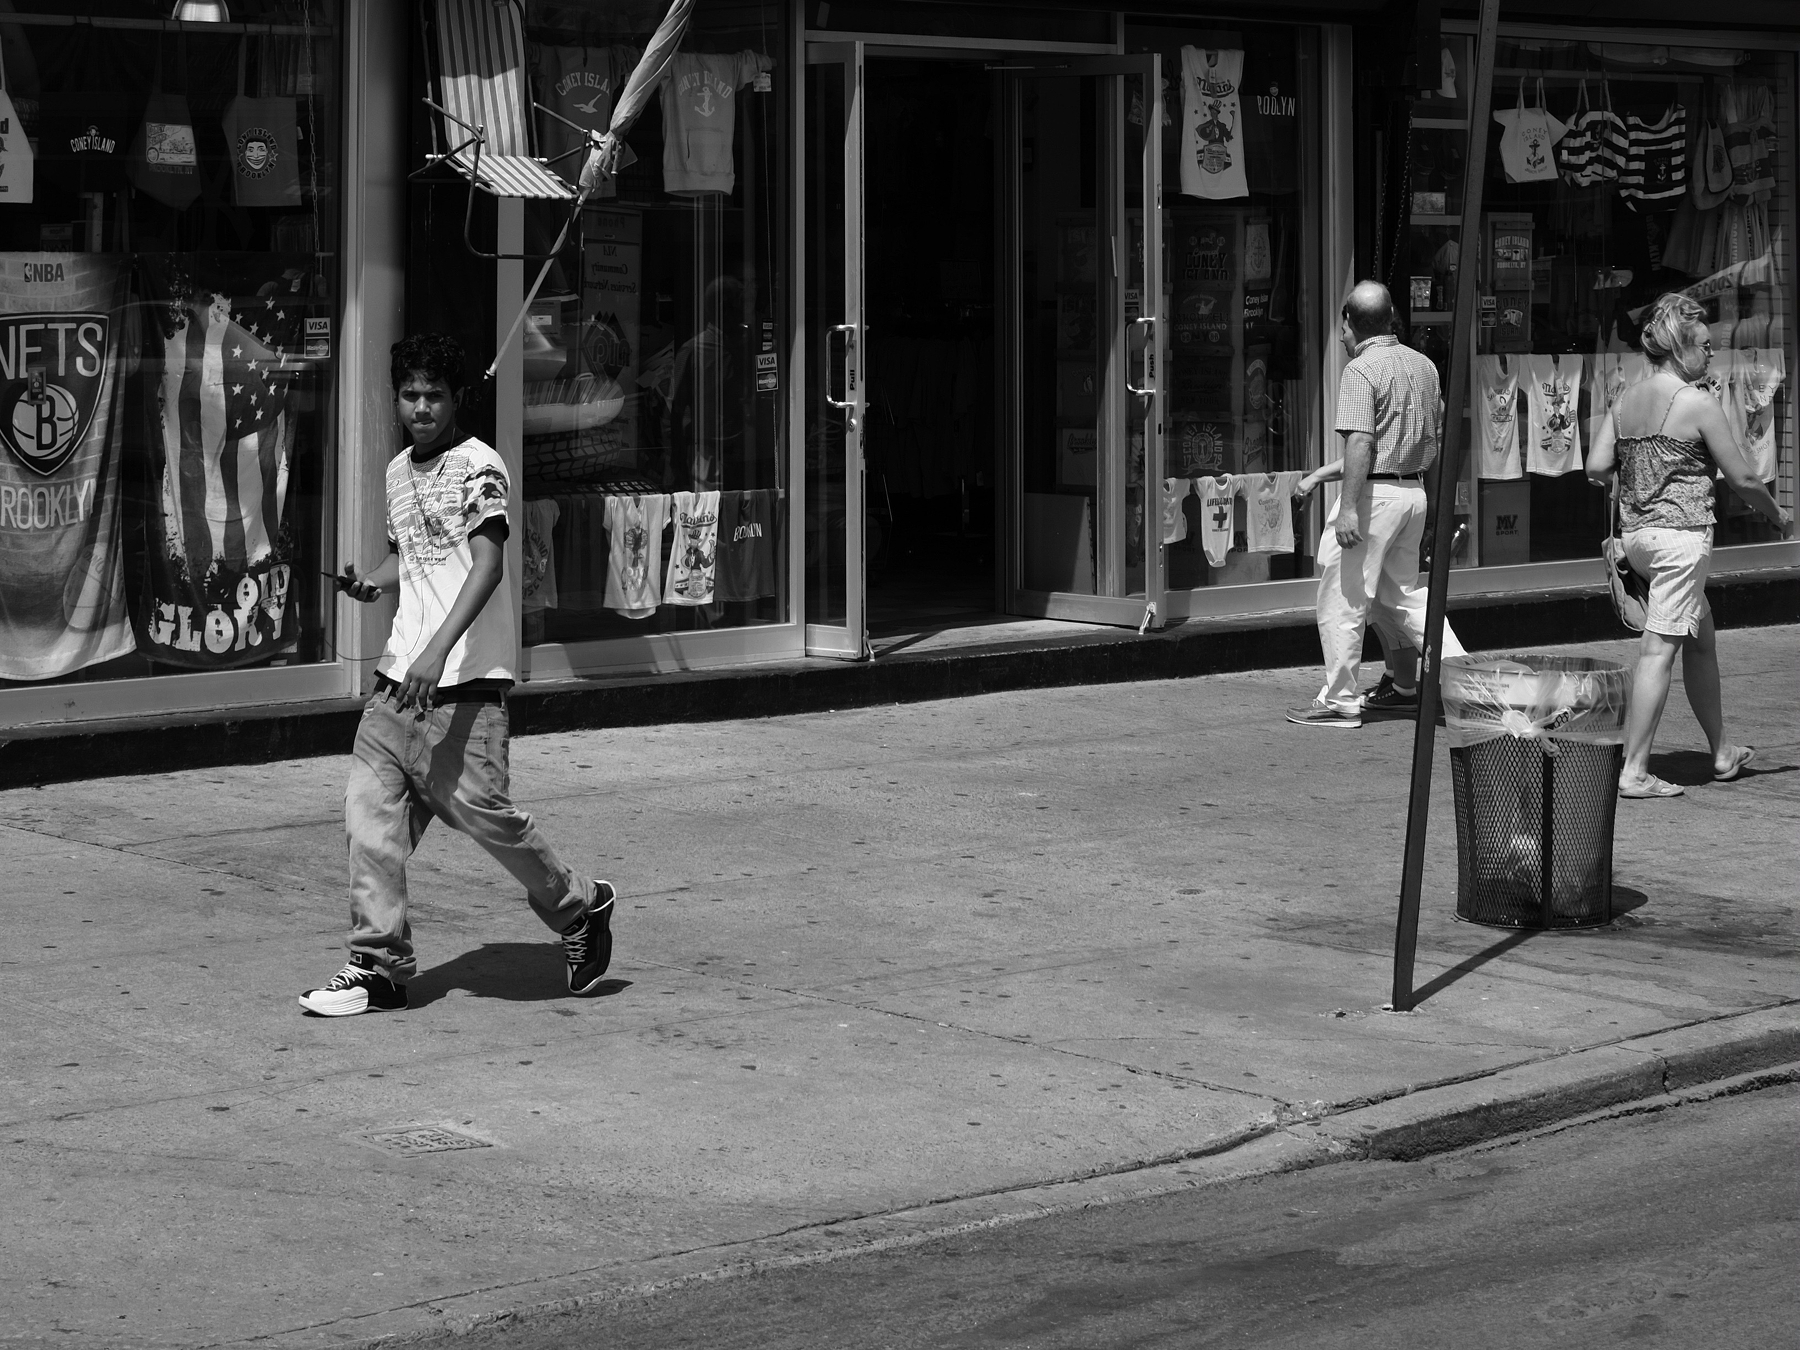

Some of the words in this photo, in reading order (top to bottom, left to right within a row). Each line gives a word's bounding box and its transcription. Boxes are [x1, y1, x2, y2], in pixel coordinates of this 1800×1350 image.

[554, 71, 582, 97] CONEY
[69, 135, 91, 153] CONEY
[91, 134, 116, 154] ISLAND
[31, 262, 65, 282] NBA
[307, 321, 328, 330] VISA
[1199, 322, 1228, 331] ISLAND
[760, 356, 775, 367] VISA
[1202, 422, 1224, 453] ISLAND
[0, 478, 97, 530] ROOKLY
[1496, 515, 1519, 529] MV
[1496, 529, 1519, 537] SPORT
